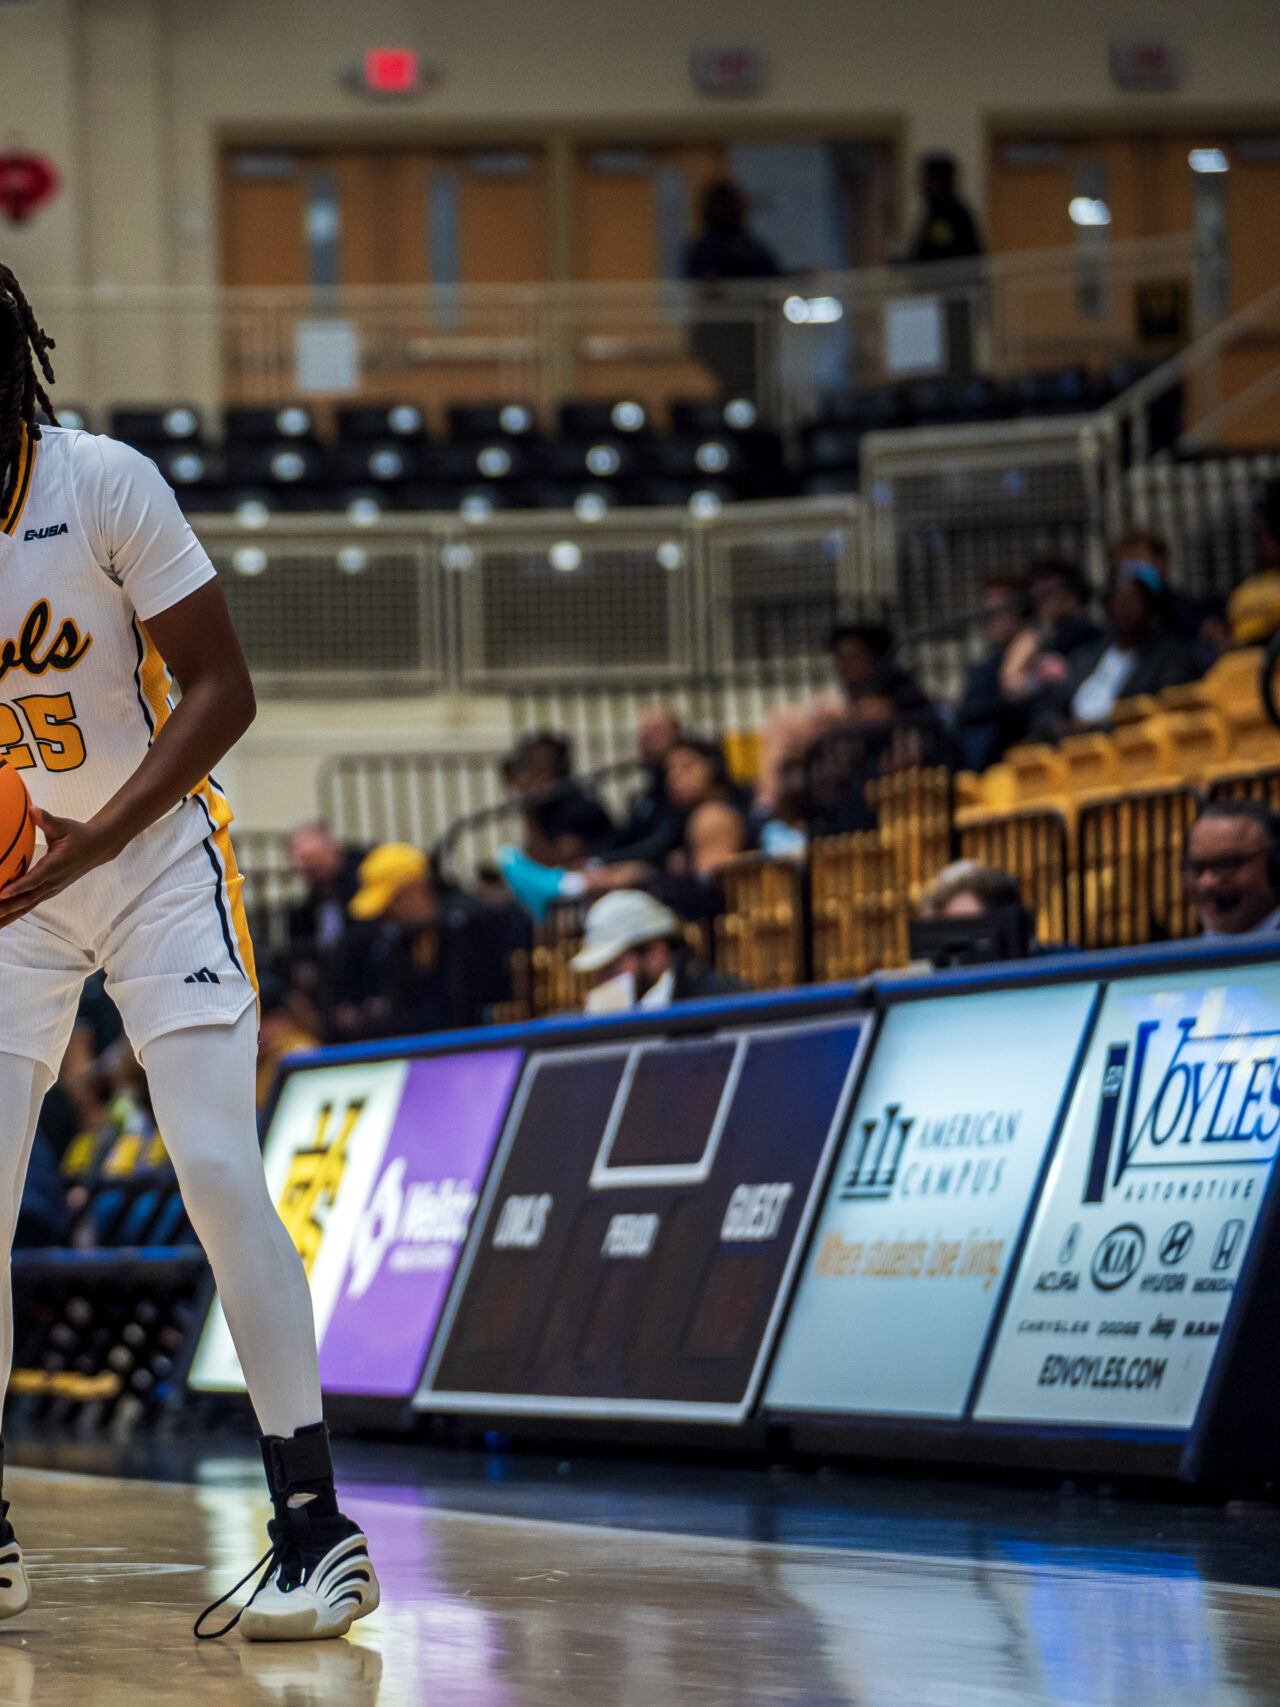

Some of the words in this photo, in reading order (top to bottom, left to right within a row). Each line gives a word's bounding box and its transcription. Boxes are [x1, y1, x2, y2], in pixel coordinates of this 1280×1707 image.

[918, 1108, 1024, 1148] AMERICAN
[901, 1156, 1007, 1197] CAMPUS
[1123, 1177, 1256, 1201] AUTOMOTIVE
[1098, 1237, 1138, 1274] KIA
[1033, 1270, 1082, 1292] ACURA
[1019, 1318, 1091, 1334] CHRYSLER
[1096, 1319, 1142, 1336] DODGE
[1182, 1319, 1221, 1337] RAM
[1036, 1353, 1169, 1390] EDVOYLES.COM
